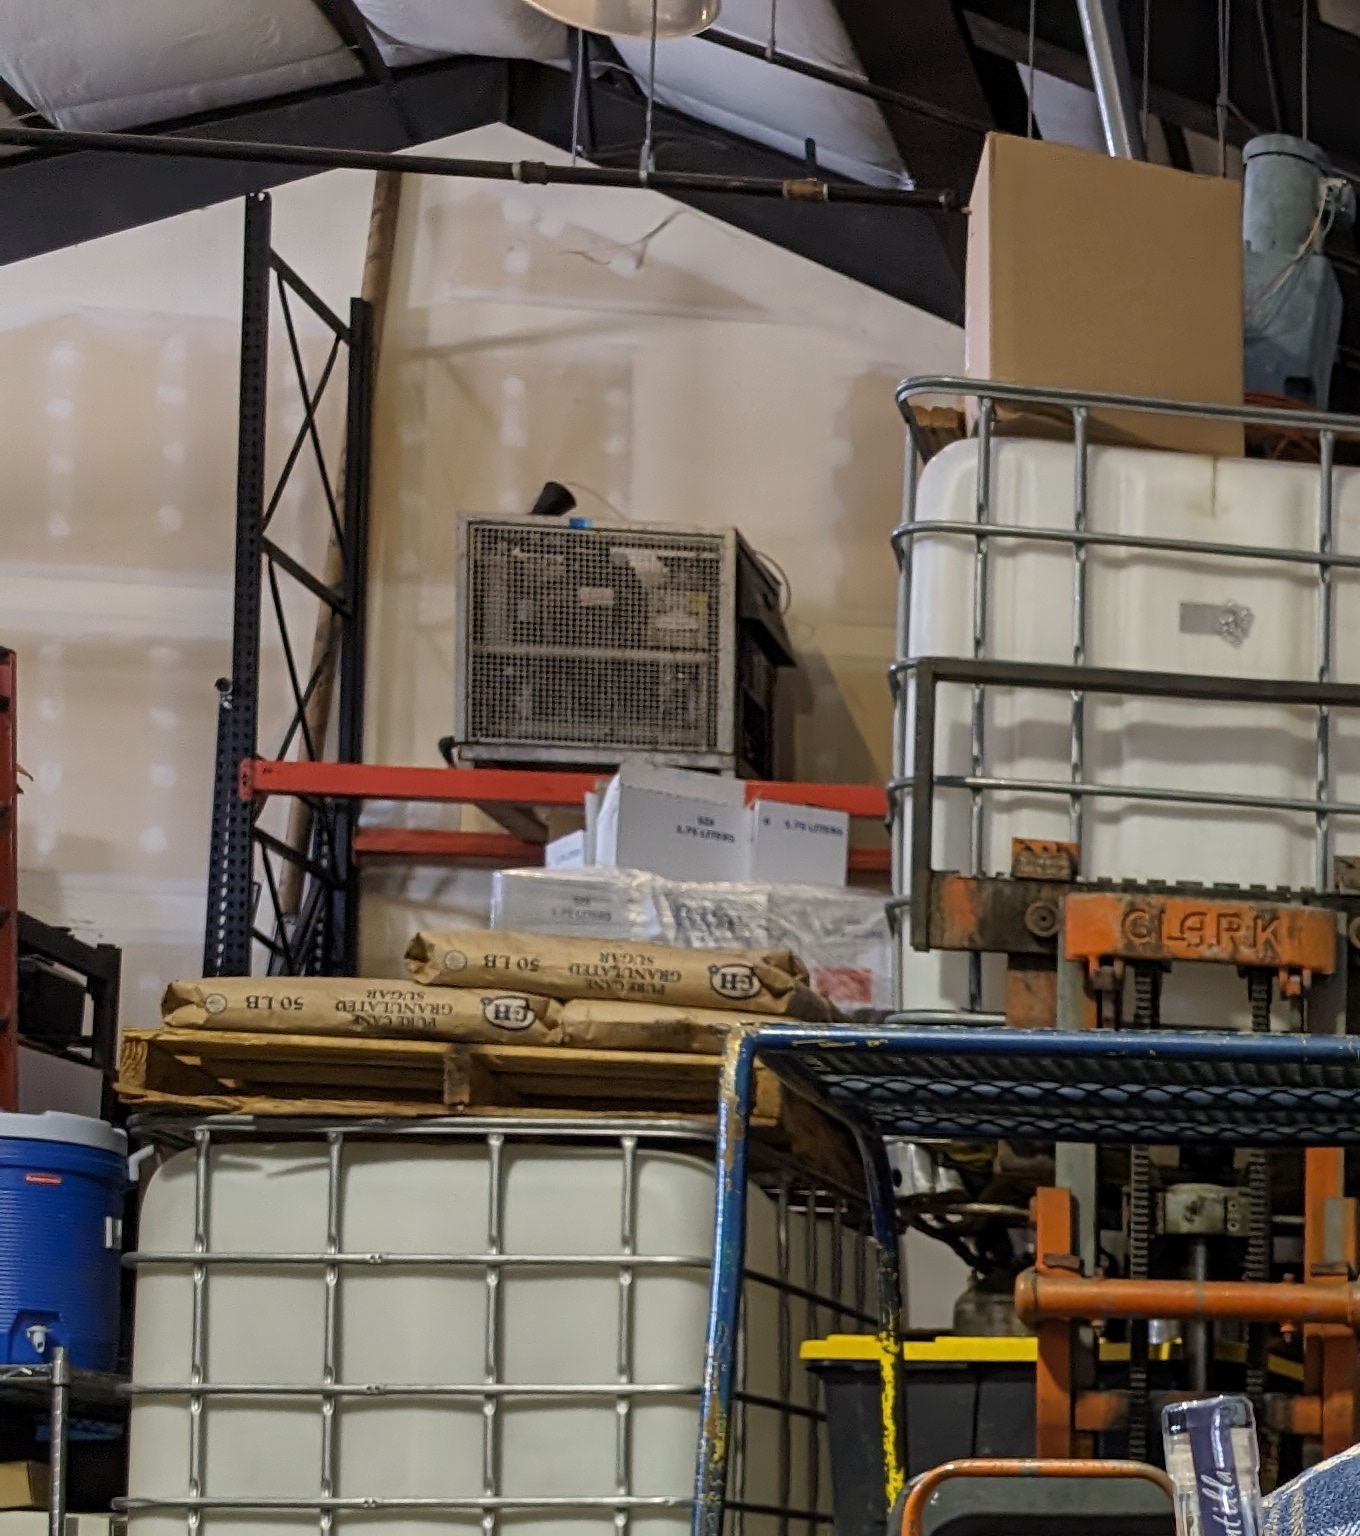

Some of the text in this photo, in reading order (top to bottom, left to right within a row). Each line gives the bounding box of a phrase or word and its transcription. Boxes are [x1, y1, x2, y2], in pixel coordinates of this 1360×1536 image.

[1121, 908, 1281, 956] CLARK
[483, 953, 540, 973] 50 LB
[599, 951, 656, 967] SUGAR
[568, 963, 683, 984] GRANULATED
[366, 989, 426, 1001] SUGAR
[627, 981, 665, 996] PURE
[245, 994, 304, 1011] 50 LB
[335, 999, 454, 1016] GRANULATED
